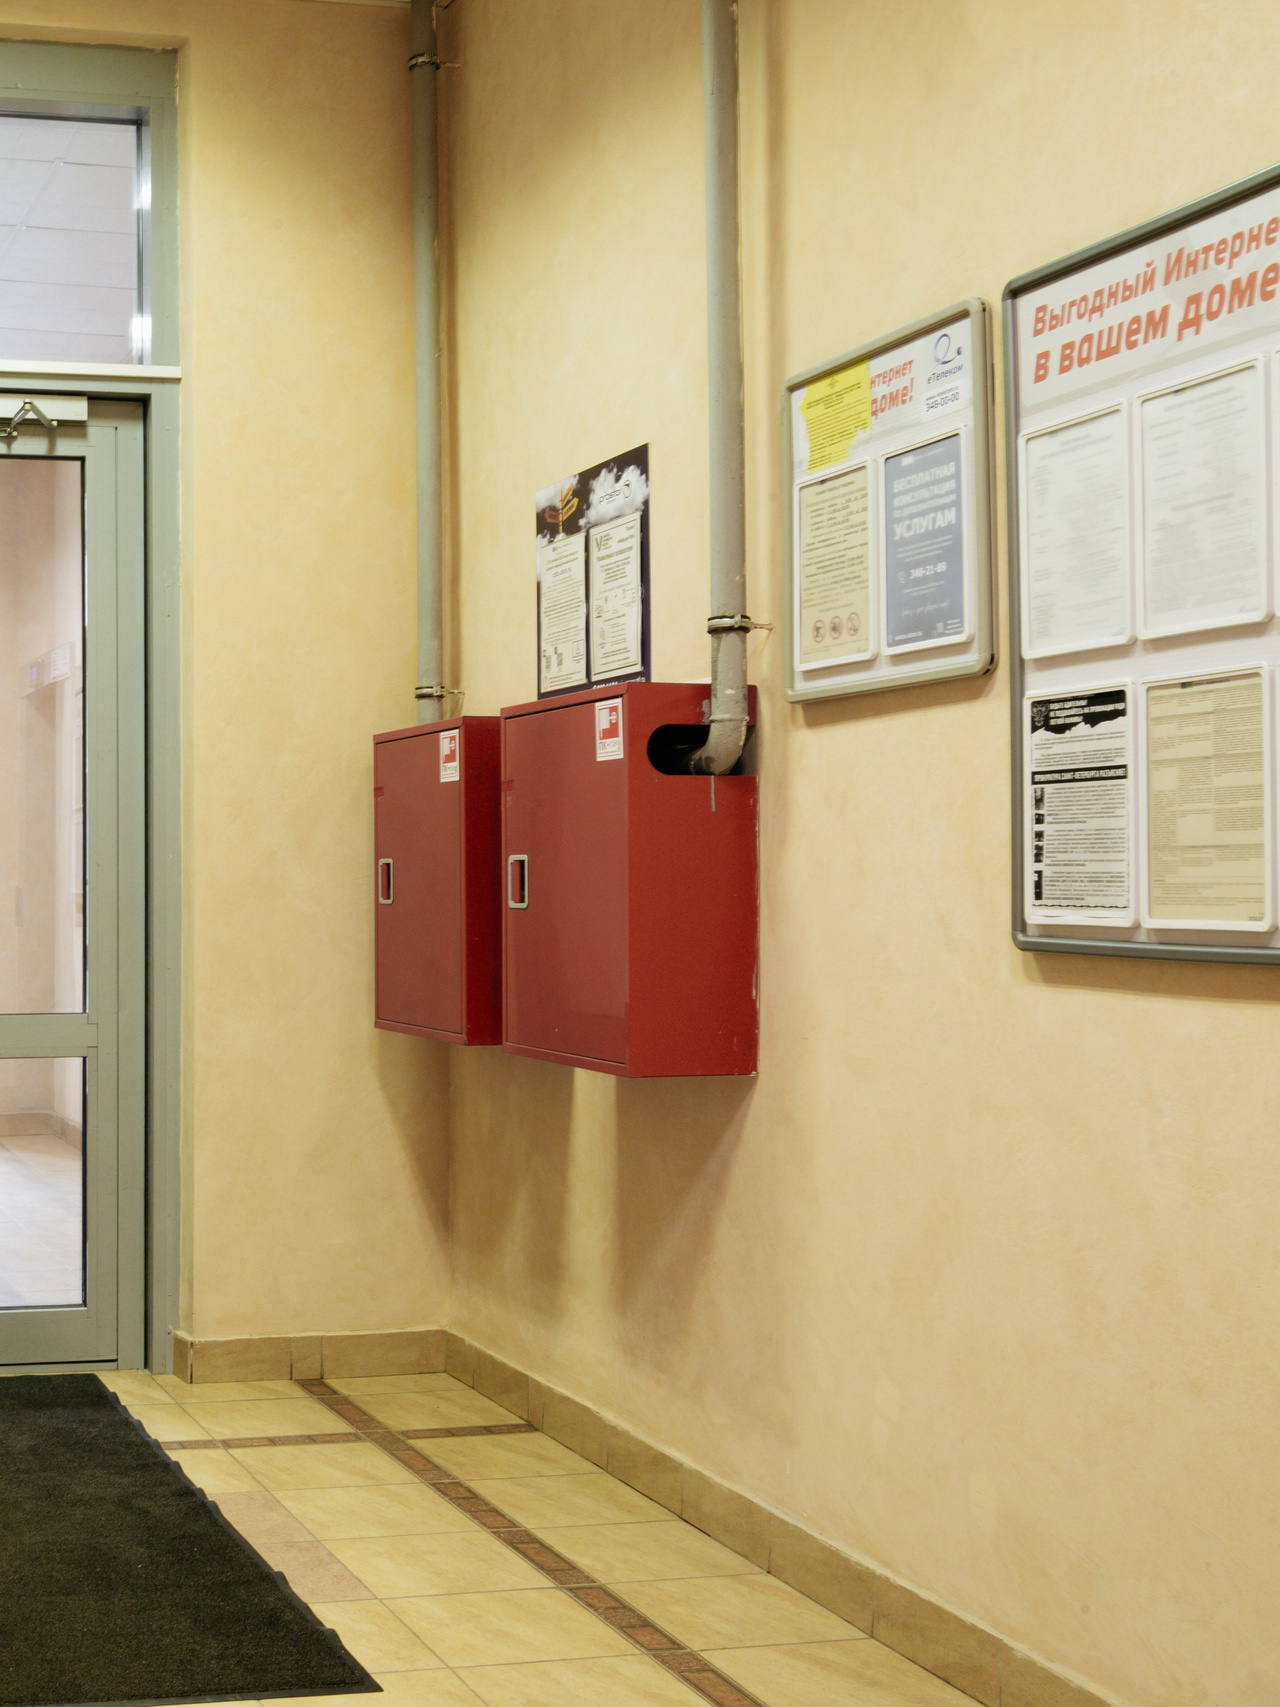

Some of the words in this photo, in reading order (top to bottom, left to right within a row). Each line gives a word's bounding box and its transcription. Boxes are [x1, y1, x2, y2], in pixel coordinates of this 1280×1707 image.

[1032, 259, 1157, 338] Выгодный
[1033, 350, 1051, 384] в
[1058, 303, 1171, 375] вашем
[925, 391, 960, 413] 348-00-00
[893, 461, 955, 493] БЕСПЛАТНАЯ
[893, 507, 956, 540] УСЛУГАМ
